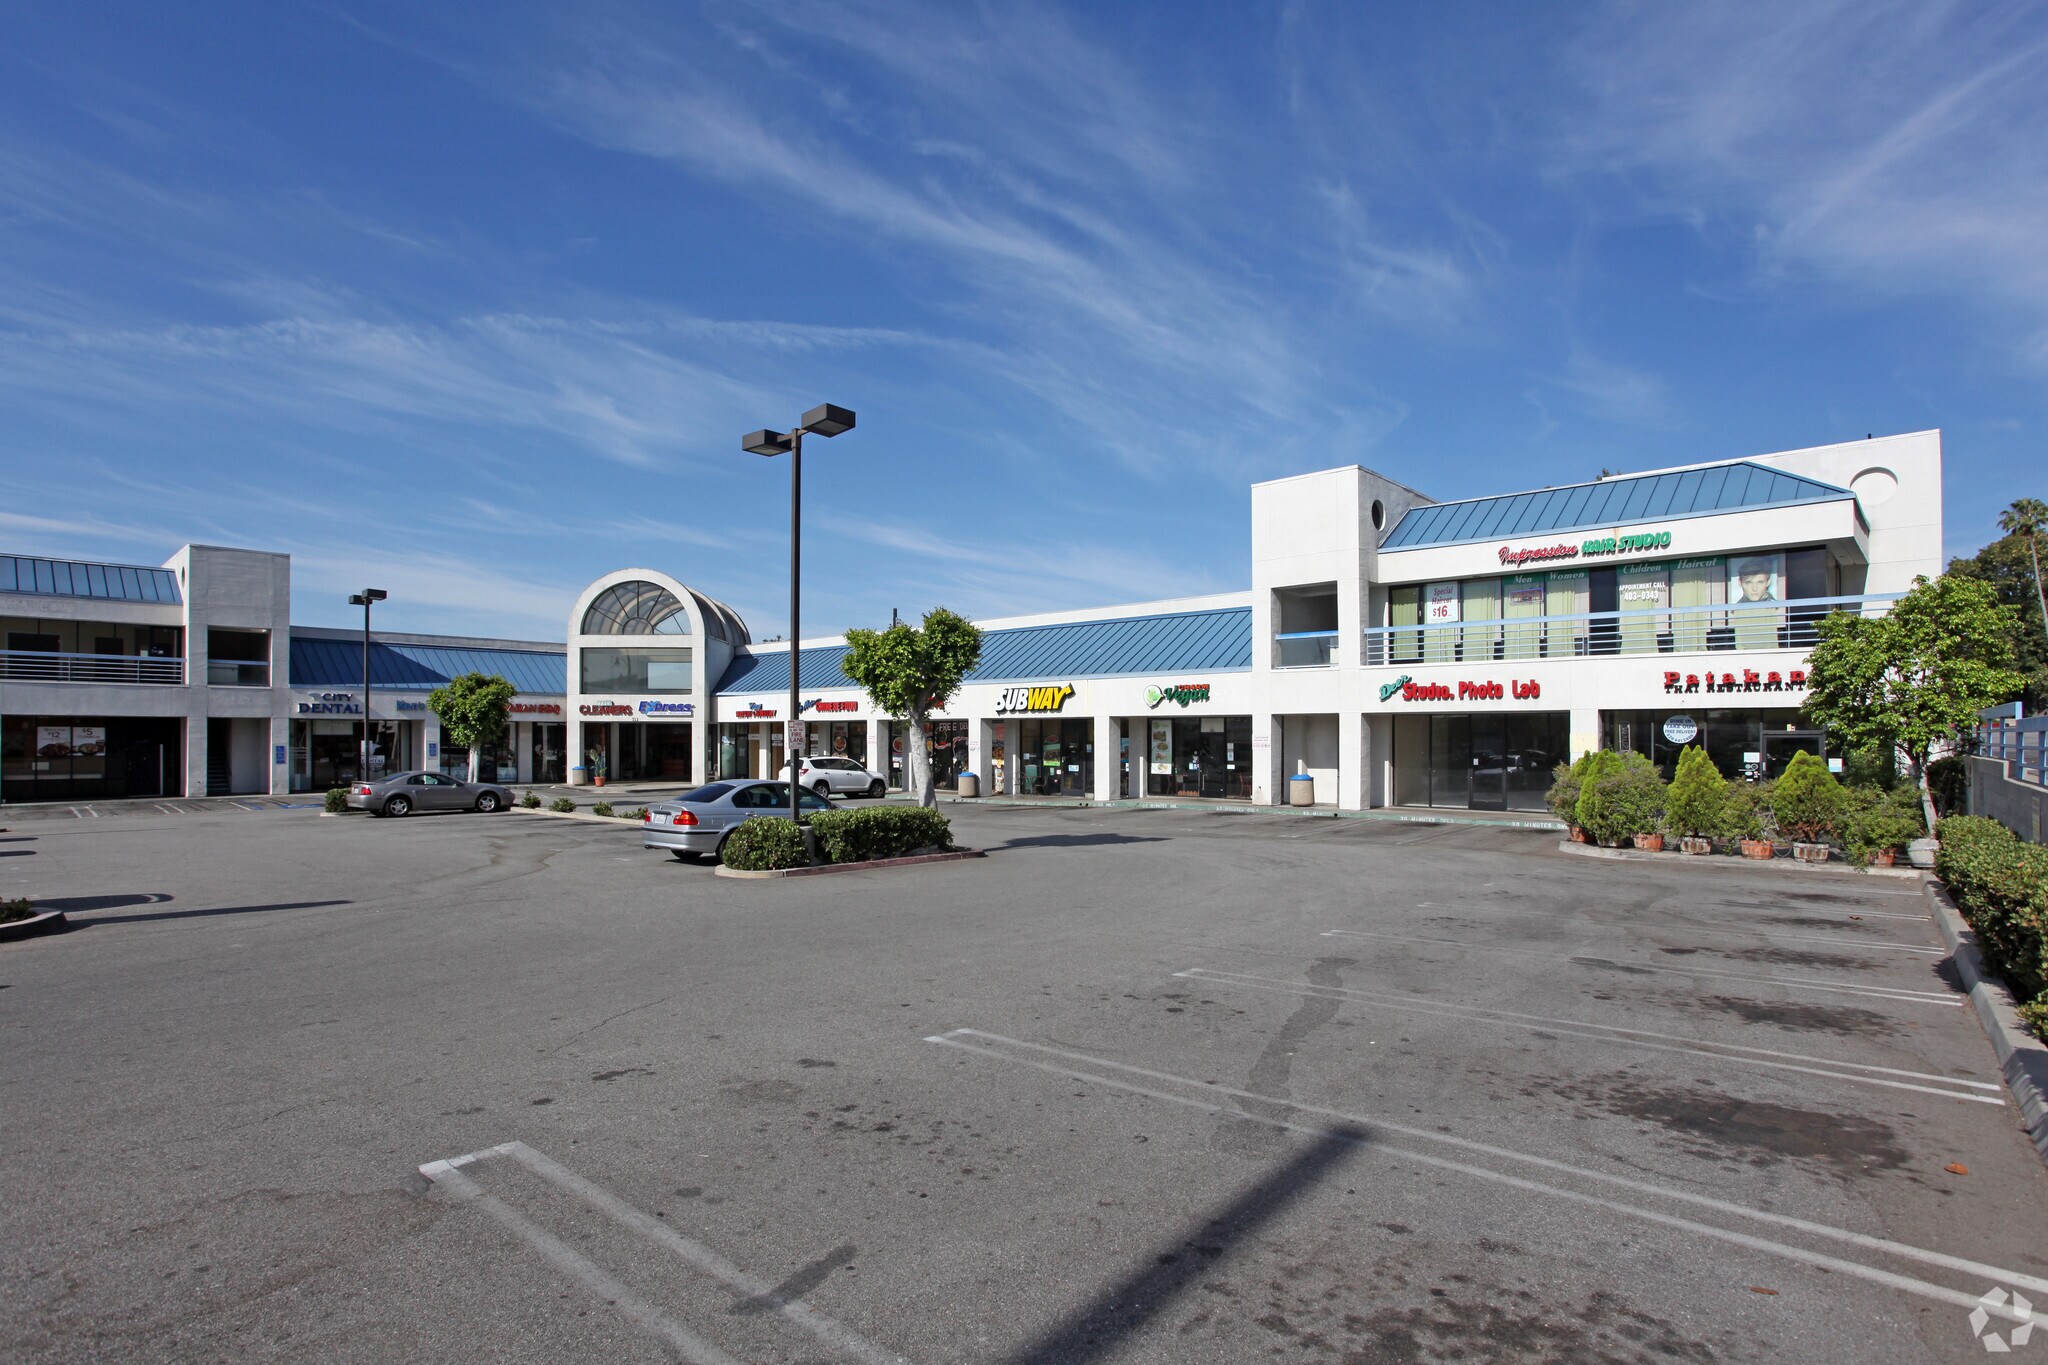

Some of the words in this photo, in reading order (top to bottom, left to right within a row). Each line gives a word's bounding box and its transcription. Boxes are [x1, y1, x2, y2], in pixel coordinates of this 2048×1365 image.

[1498, 545, 1578, 567] Impression
[1582, 538, 1616, 556] HAIR
[1618, 532, 1671, 552] STUDIO
[1514, 575, 1532, 584] Men
[1549, 571, 1585, 580] Women
[1622, 563, 1661, 574] Children
[1677, 558, 1717, 569] Haircut
[1433, 586, 1453, 596] Special
[1619, 582, 1652, 591] APPOINTMENT
[1433, 605, 1448, 617] $16
[1664, 669, 1806, 685] Patakan
[1458, 680, 1504, 700] Photo
[1512, 679, 1540, 699] Lab
[1664, 683, 1699, 694] THAI
[1706, 681, 1806, 693] RESTAURANT
[322, 693, 352, 701] CITY
[995, 685, 1075, 713] SUBWAY
[1164, 686, 1210, 706] Vegan
[298, 703, 363, 714] DENTAL
[579, 704, 634, 716] CLEANERS
